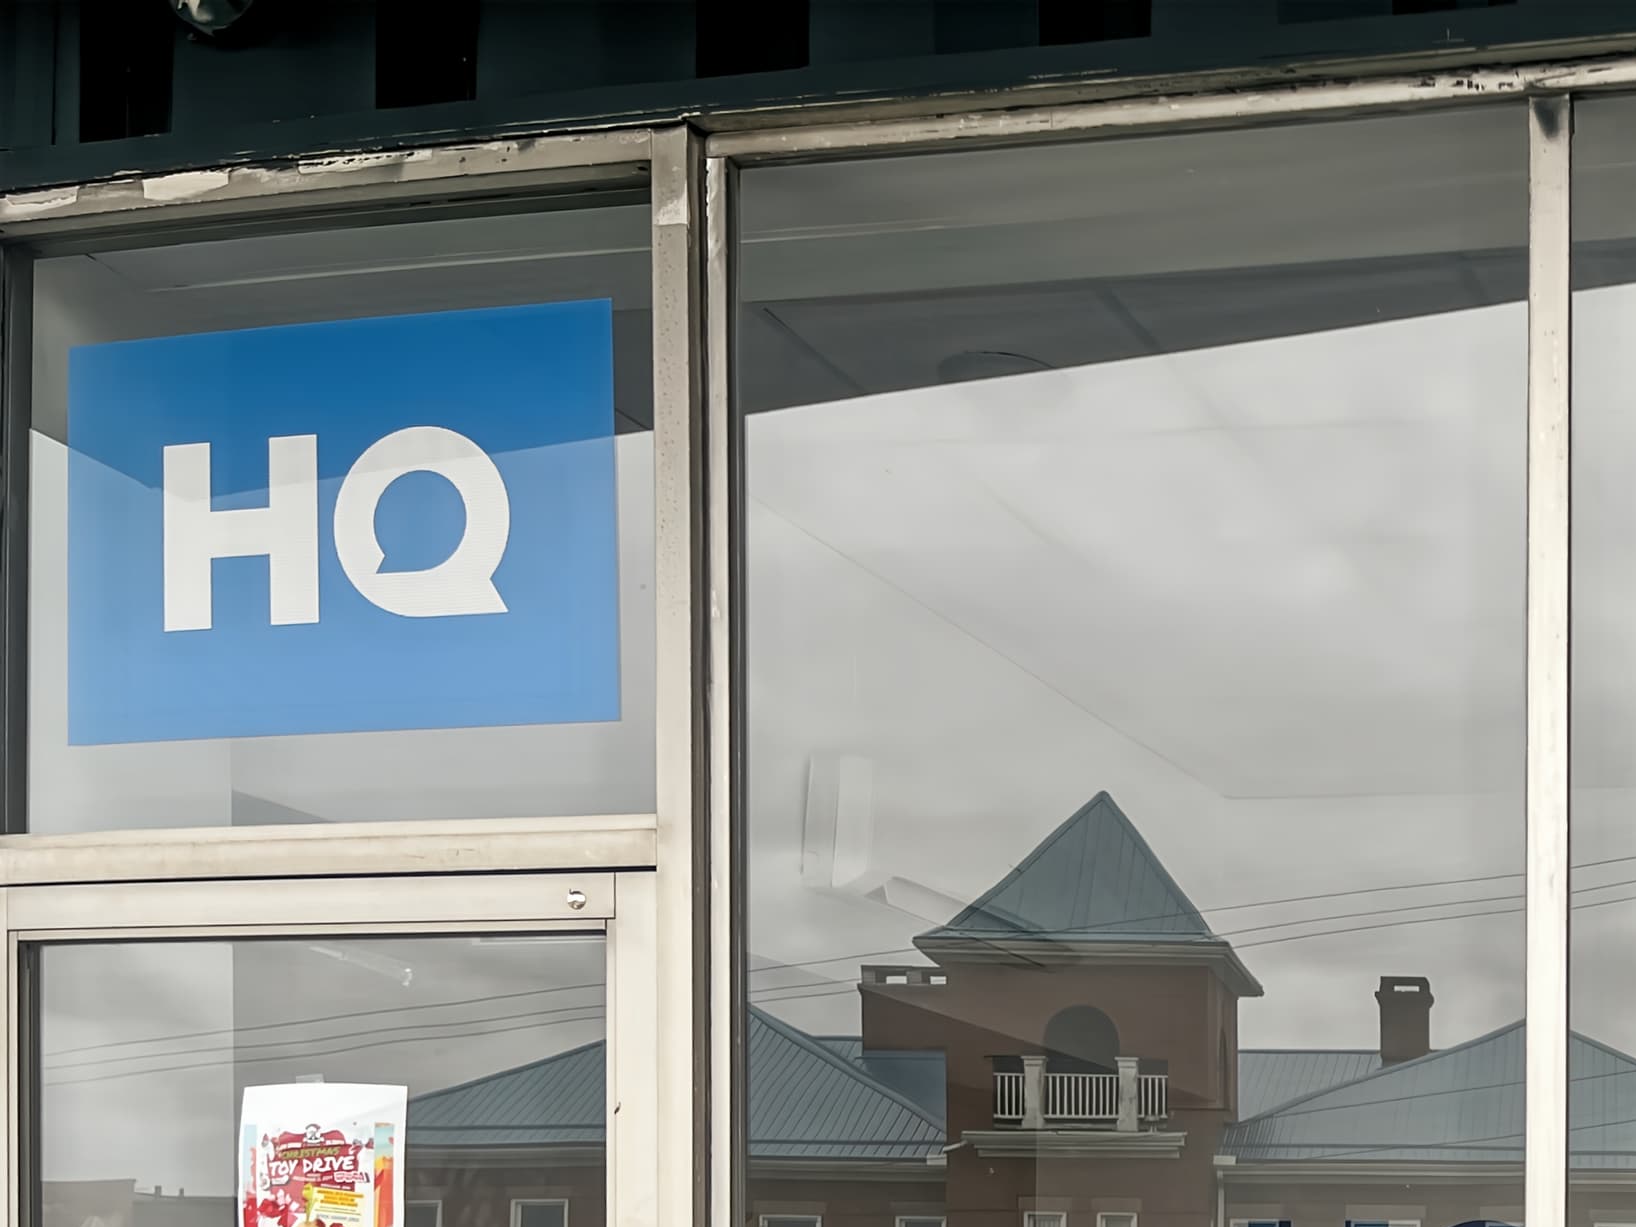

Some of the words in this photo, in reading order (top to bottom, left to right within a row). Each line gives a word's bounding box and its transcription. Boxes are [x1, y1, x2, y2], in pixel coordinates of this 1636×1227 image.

[163, 426, 511, 633] HQ
[269, 1159, 298, 1177] TOY
[303, 1155, 355, 1174] DRIVE
